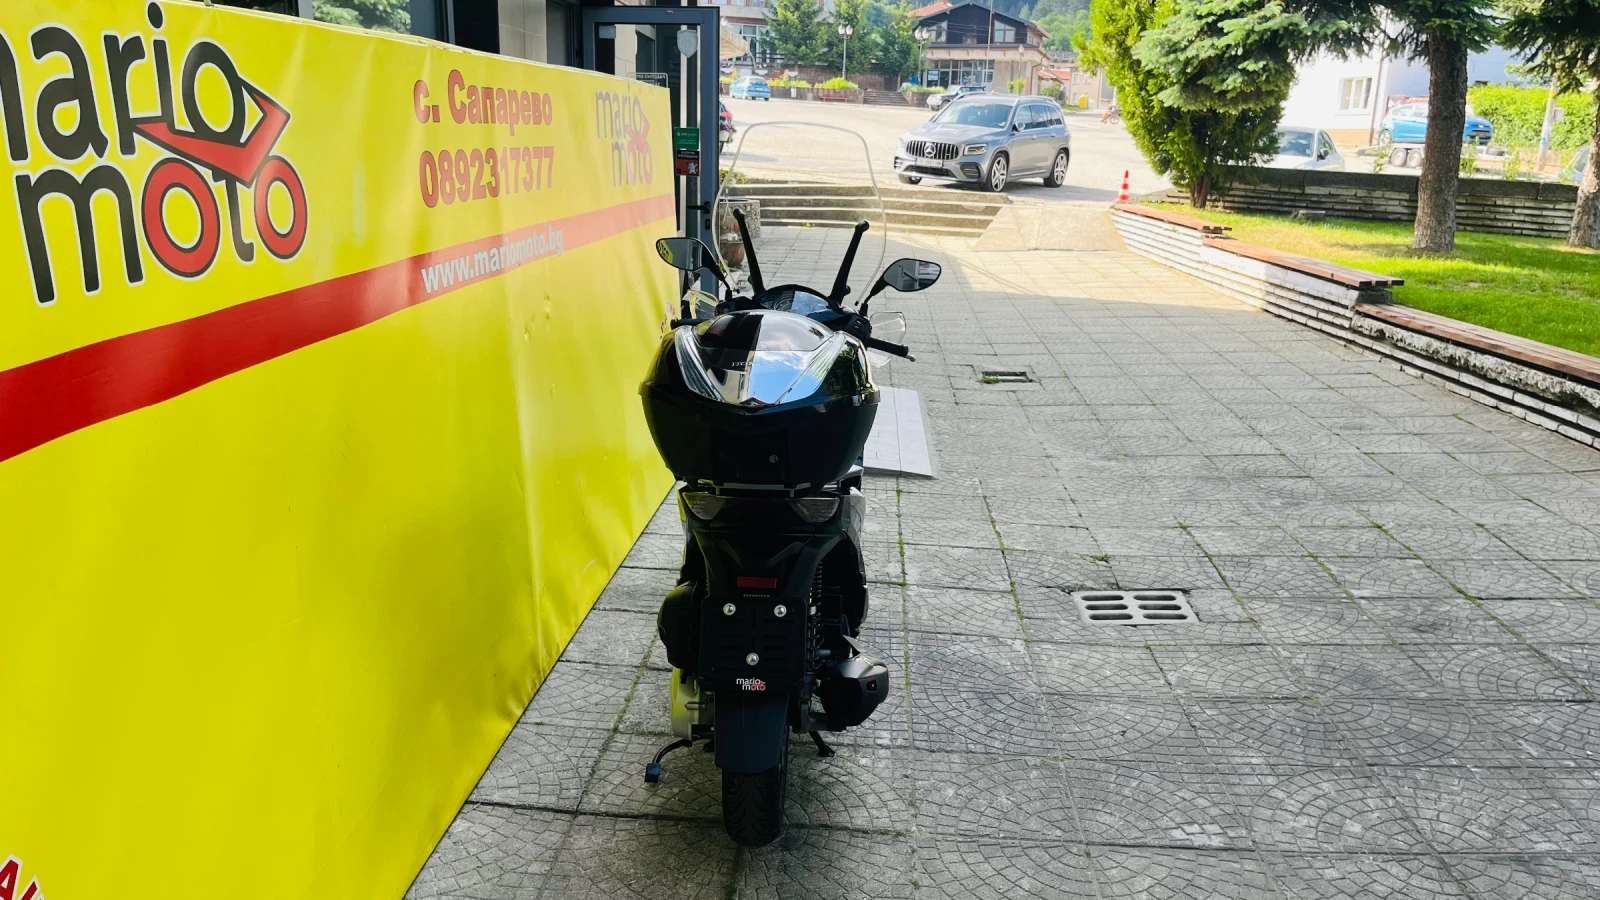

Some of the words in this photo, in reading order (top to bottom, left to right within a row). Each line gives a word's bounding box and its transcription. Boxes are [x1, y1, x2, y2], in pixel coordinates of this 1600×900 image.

[448, 69, 553, 136] Сапарево
[595, 83, 643, 139] mario
[419, 146, 554, 208] 0892317377
[612, 140, 654, 187] moto
[15, 156, 308, 304] moto
[420, 226, 563, 294] www.mariomoto.bg
[736, 677, 761, 685] mario
